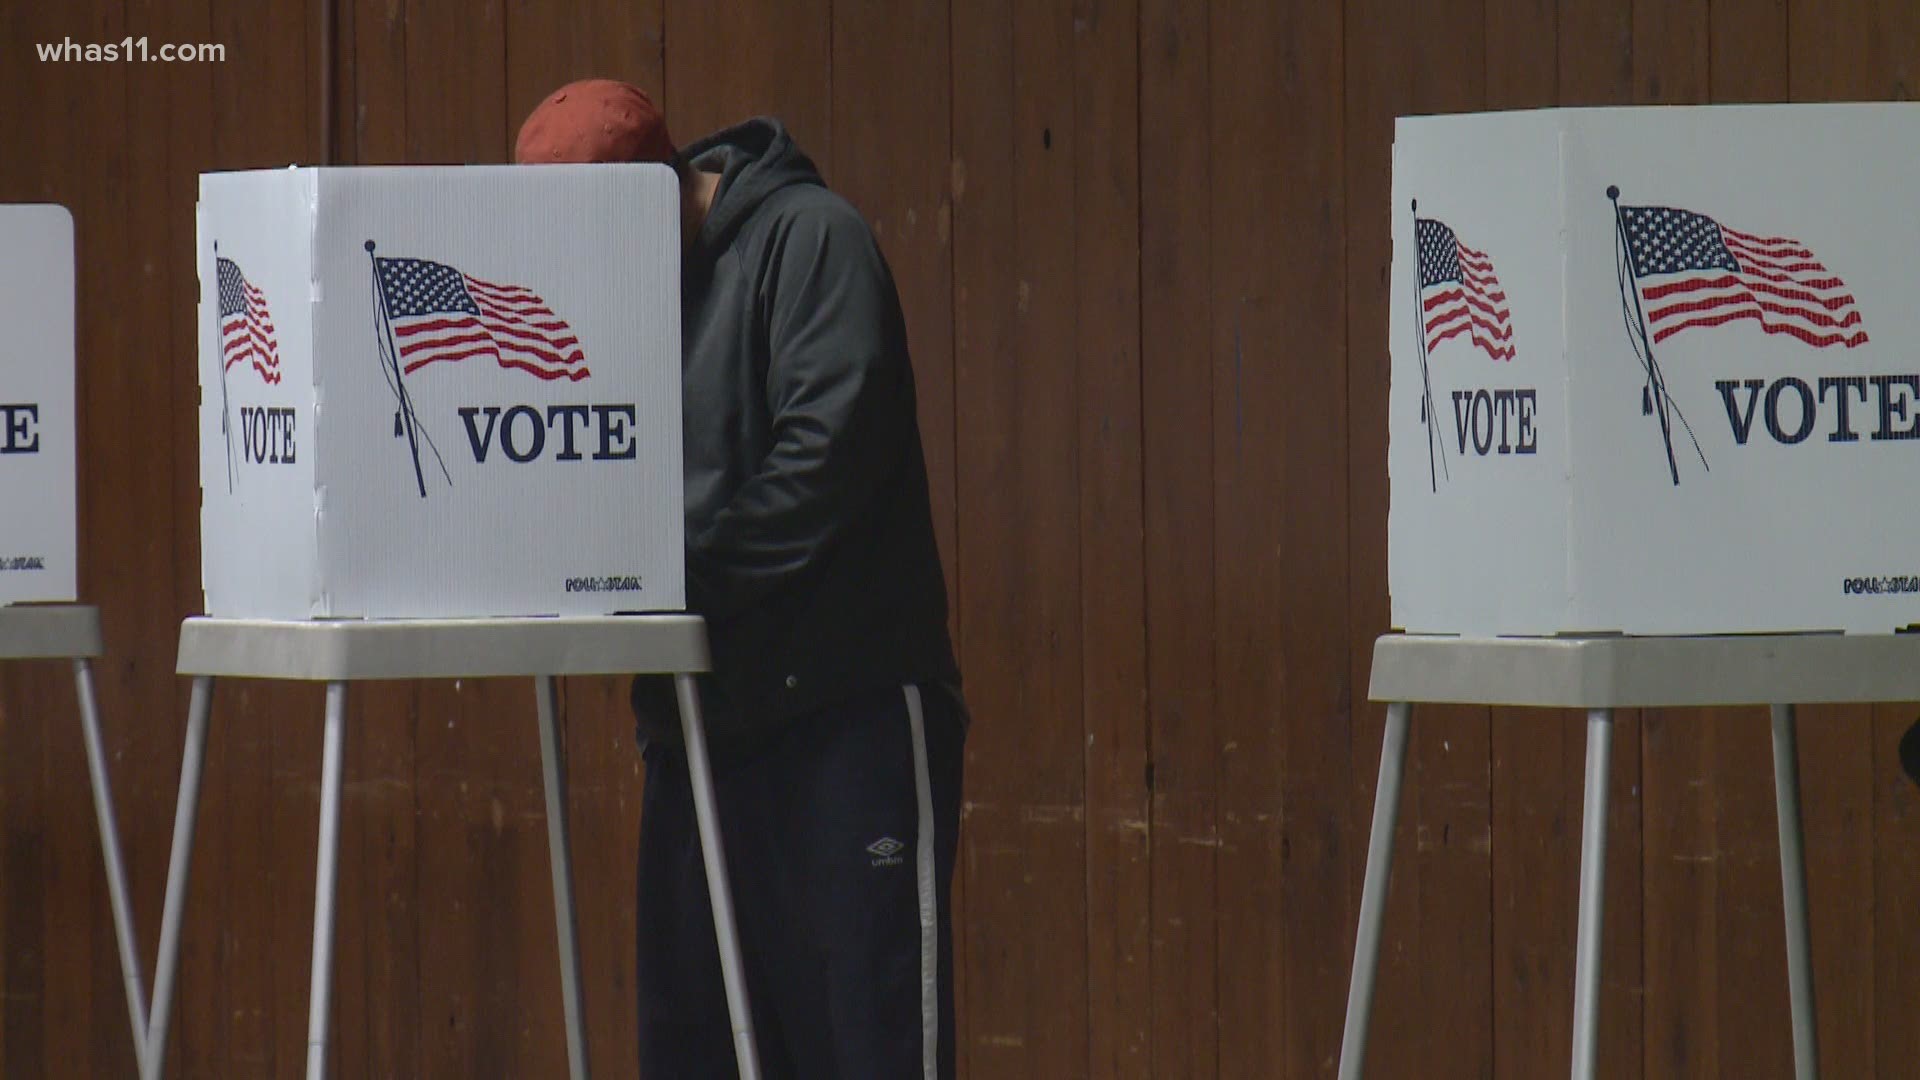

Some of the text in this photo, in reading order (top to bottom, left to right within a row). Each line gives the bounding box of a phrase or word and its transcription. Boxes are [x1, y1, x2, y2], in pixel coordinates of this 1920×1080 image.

[241, 407, 296, 464] VOTE
[458, 403, 637, 464] VOTE
[1452, 389, 1536, 456] VOTE
[1715, 375, 1920, 445] VOTE
